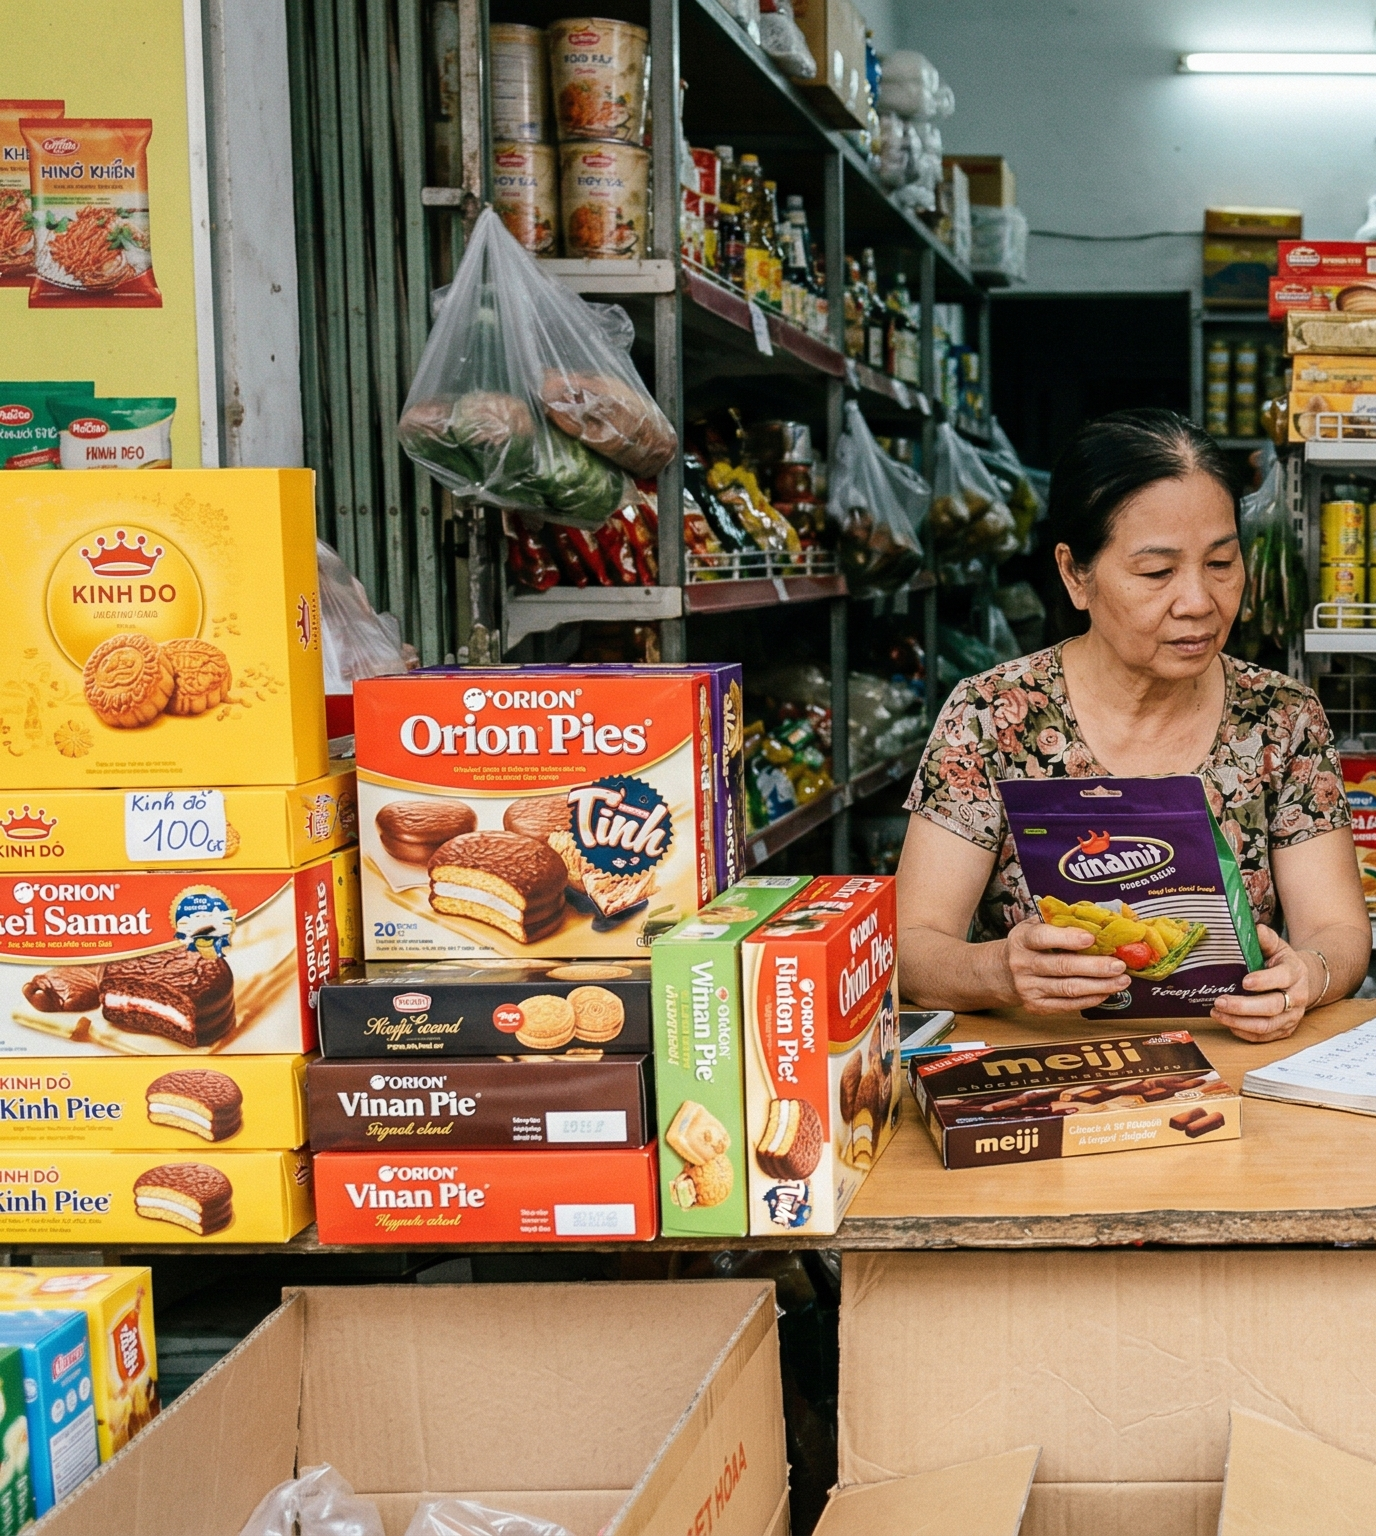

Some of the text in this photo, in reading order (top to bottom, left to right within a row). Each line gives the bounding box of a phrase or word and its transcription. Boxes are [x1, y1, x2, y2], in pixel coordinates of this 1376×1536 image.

[73, 584, 176, 604] KINH DO
[492, 689, 575, 709] ORION
[400, 713, 648, 756] Orion Pies
[131, 791, 175, 812] Kinh
[567, 787, 669, 858] Tinh
[1069, 843, 1162, 880] vinamit
[39, 883, 115, 902] ORION
[44, 905, 152, 936] Samat
[374, 922, 397, 937] 20
[801, 996, 815, 1049] ORION
[982, 1041, 1142, 1077] meiji
[0, 1077, 41, 1090] KINH
[389, 1076, 444, 1089] ORION
[1, 1097, 121, 1119] Kinh Piee
[337, 1091, 477, 1117] Vinan Pie
[975, 1128, 1040, 1155] meiji
[397, 1167, 455, 1181] ORION
[55, 1190, 109, 1212] Piee
[344, 1183, 485, 1208] Vinan Pie
